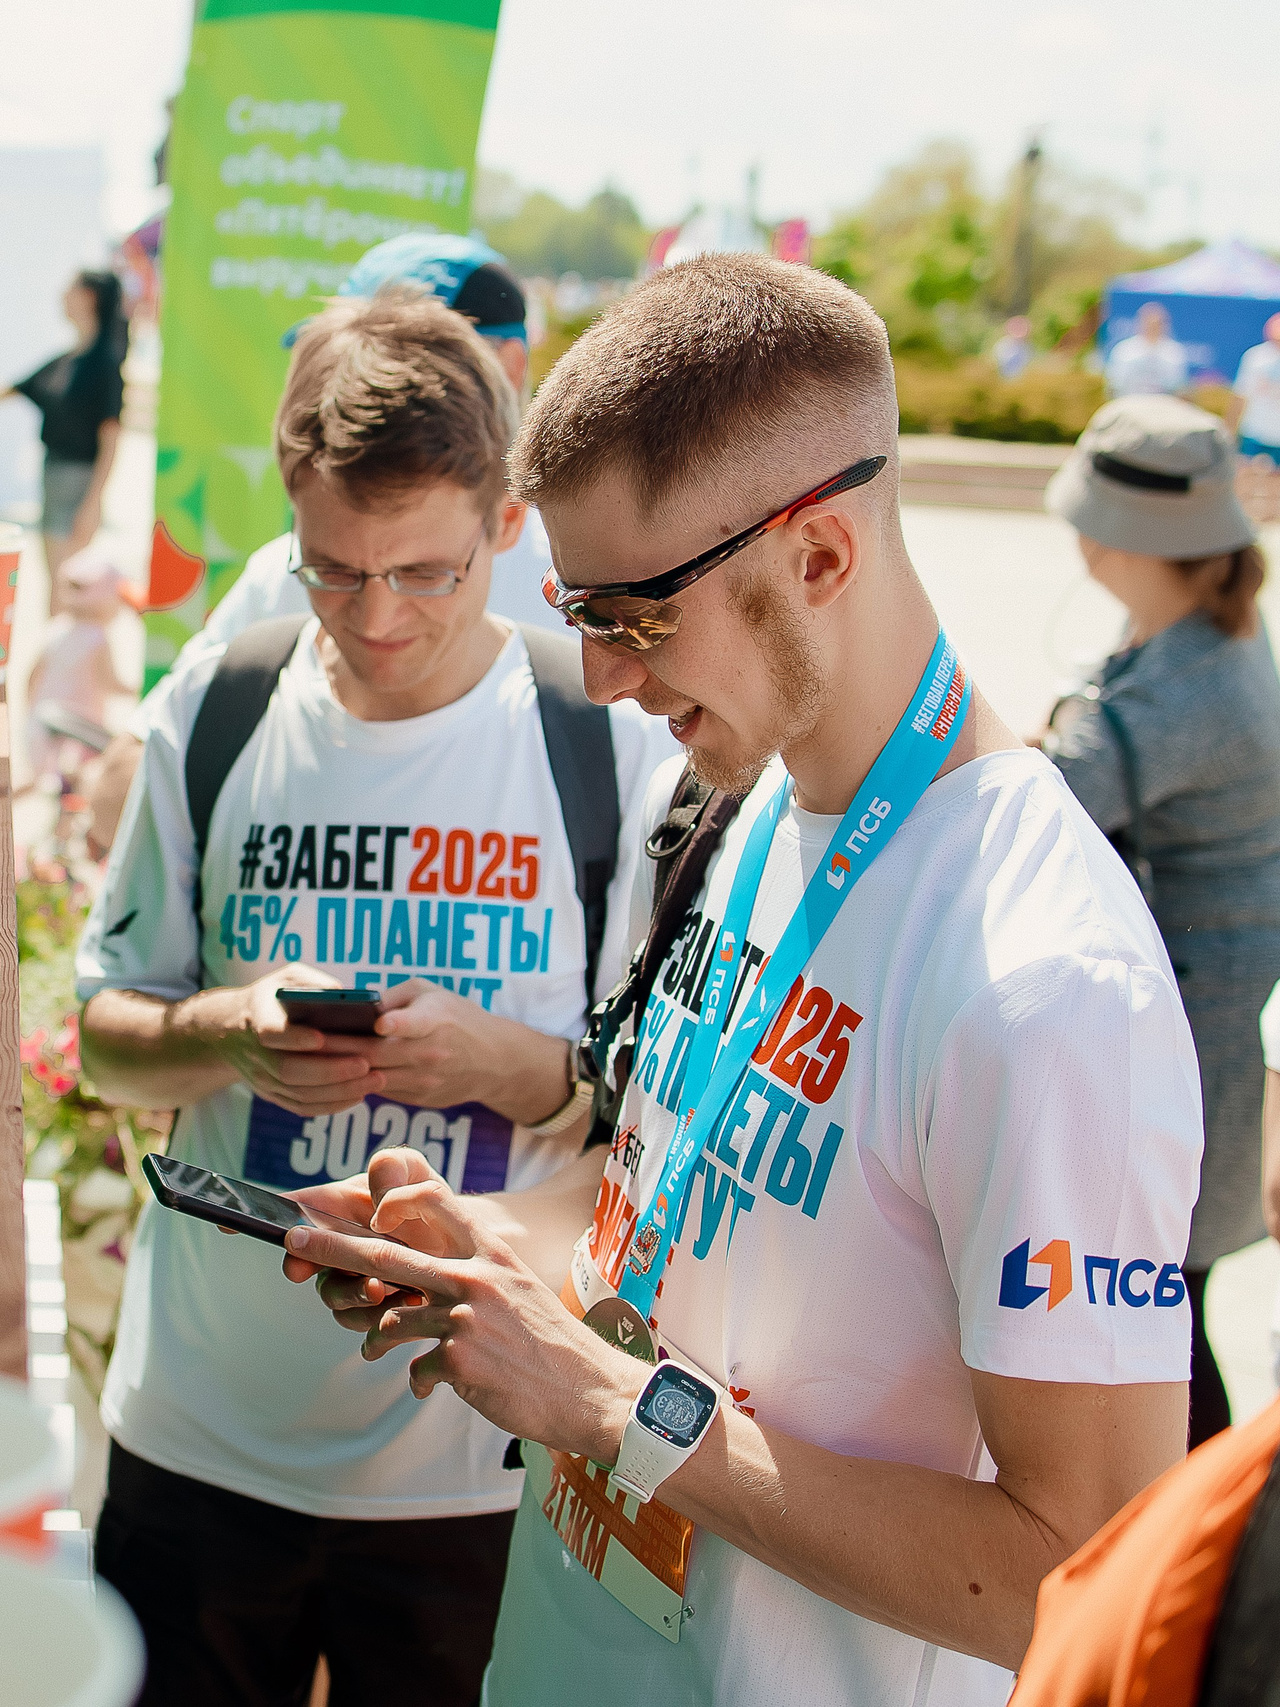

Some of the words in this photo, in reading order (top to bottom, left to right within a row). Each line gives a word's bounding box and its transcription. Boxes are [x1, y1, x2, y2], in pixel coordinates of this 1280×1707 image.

[910, 678, 946, 735] #БЕГОВАЯ
[929, 692, 961, 742] #СТРЕСС
[845, 797, 892, 854] ПСБ
[238, 824, 541, 901] #ЗАБЕГ2025
[220, 894, 302, 963] 45%
[315, 896, 554, 974] ПЛАНЕТЫ
[704, 967, 727, 1025] ПСБ
[289, 1101, 473, 1195] 30261
[665, 1137, 696, 1193] ПСБ
[1083, 1254, 1186, 1308] ПСБ
[651, 1424, 674, 1440] POLAR
